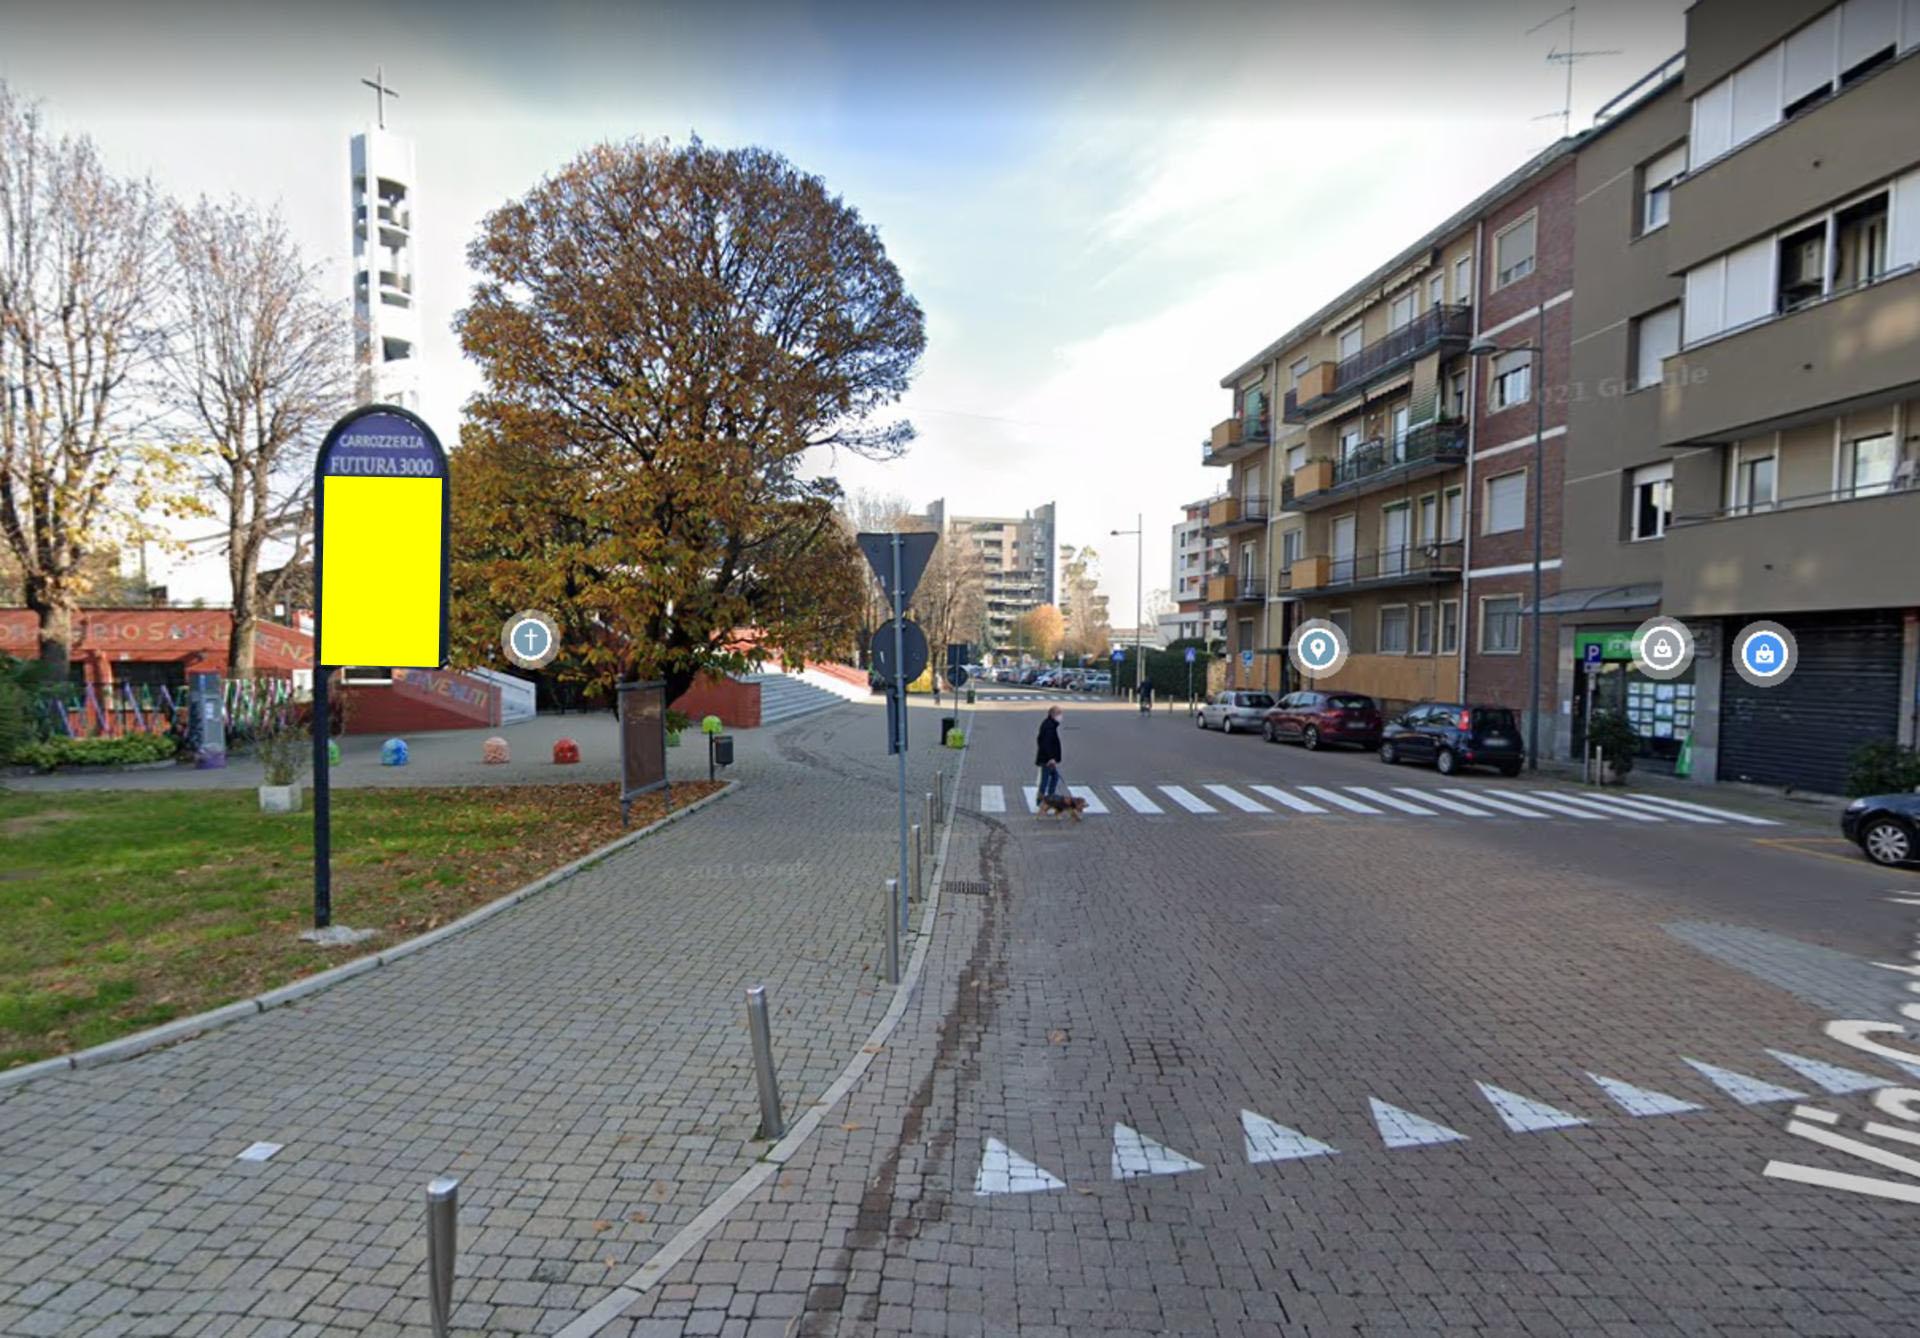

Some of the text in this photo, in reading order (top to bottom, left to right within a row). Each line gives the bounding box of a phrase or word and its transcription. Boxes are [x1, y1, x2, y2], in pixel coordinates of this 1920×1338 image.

[338, 434, 426, 449] CARROZZERIA
[330, 456, 434, 476] FUTURA 3000
[1588, 644, 1600, 662] P
